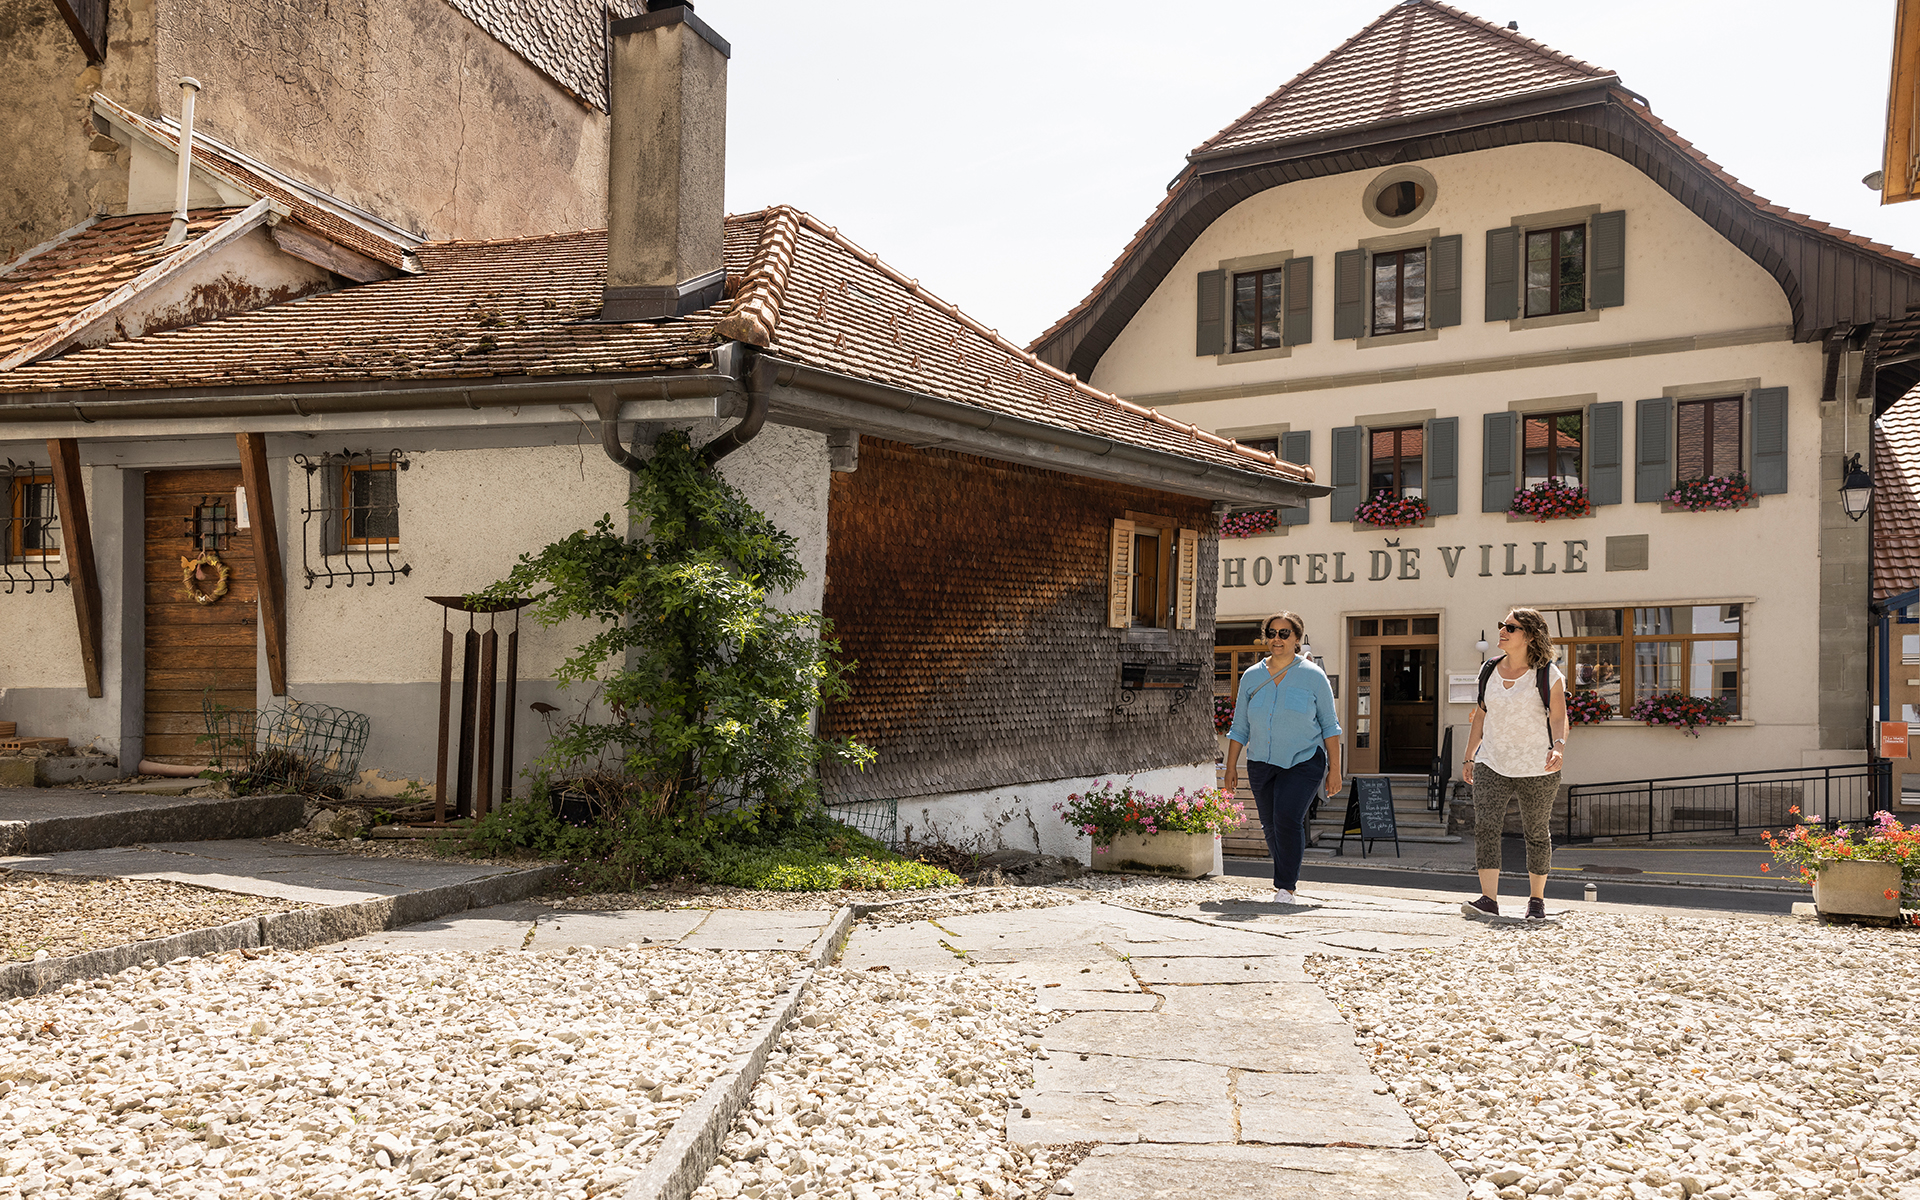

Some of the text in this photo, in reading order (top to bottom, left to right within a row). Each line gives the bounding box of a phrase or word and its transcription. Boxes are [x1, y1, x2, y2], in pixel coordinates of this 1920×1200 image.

[1221, 539, 1589, 588] HOTEL DE VILLE
